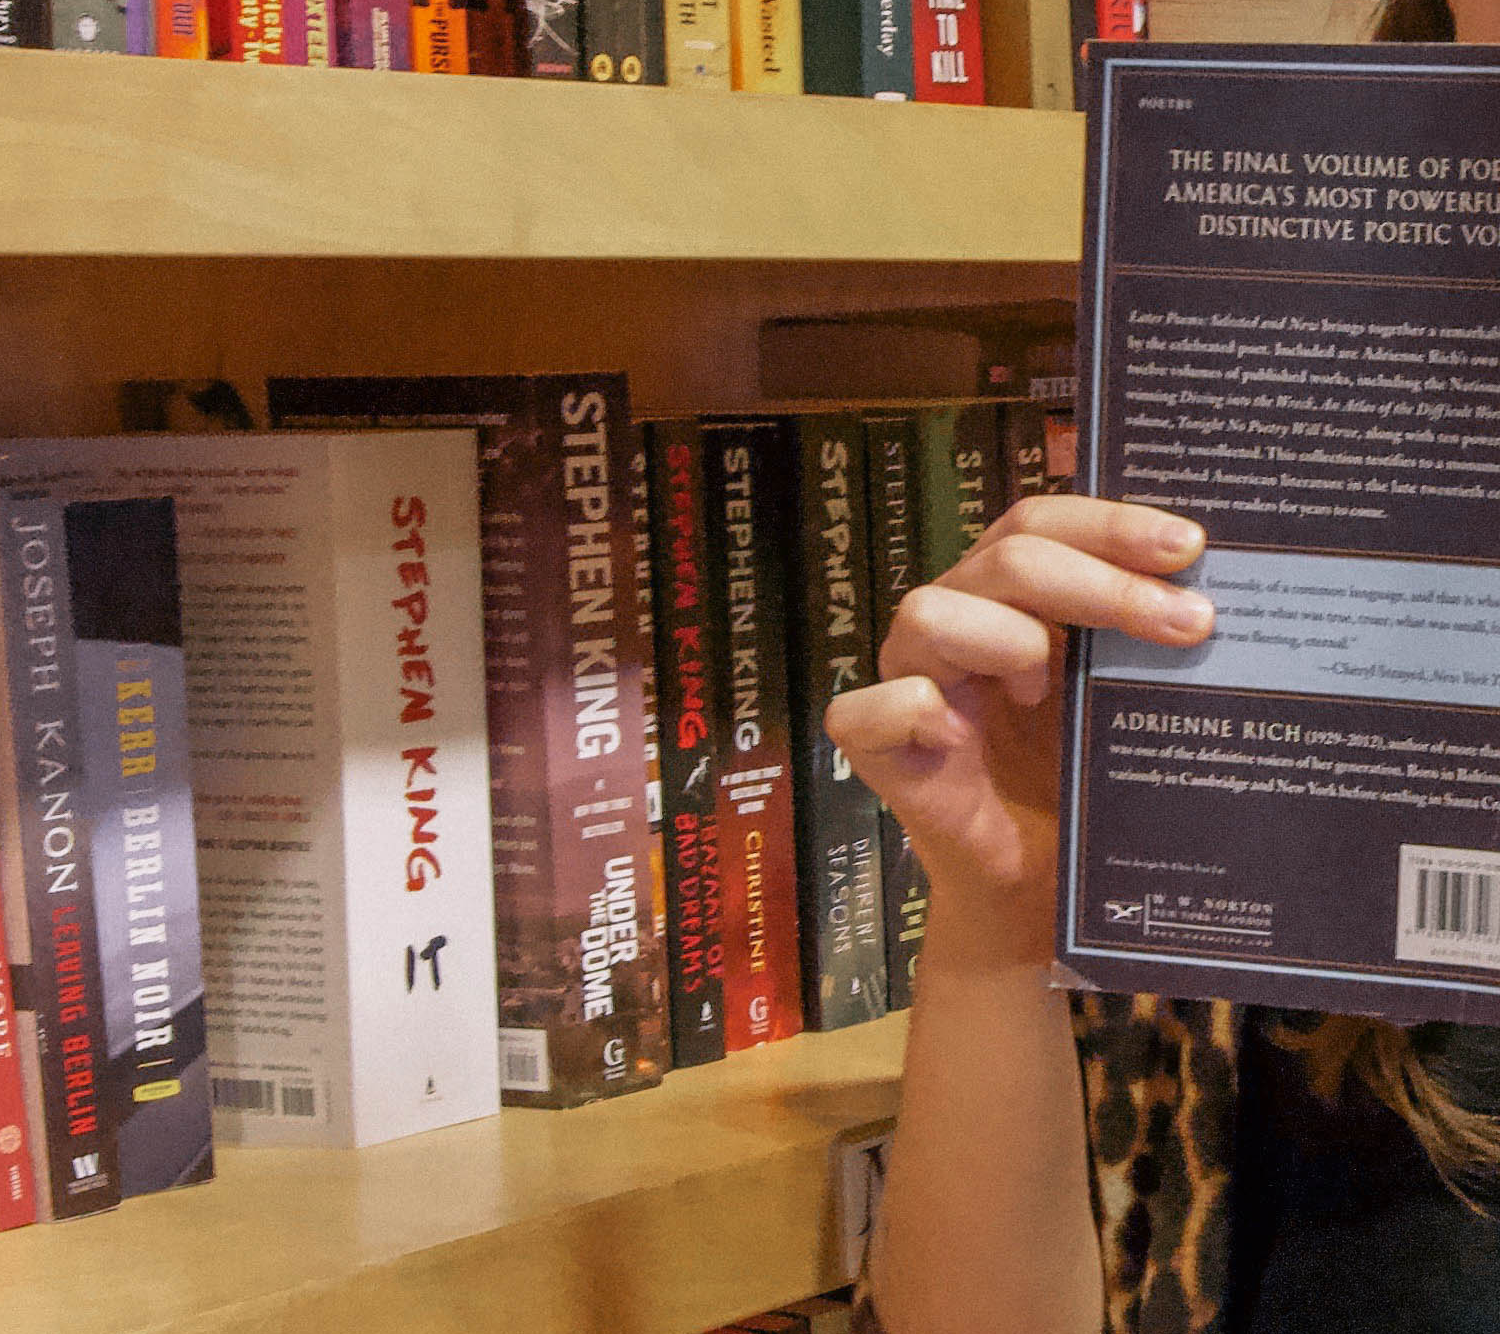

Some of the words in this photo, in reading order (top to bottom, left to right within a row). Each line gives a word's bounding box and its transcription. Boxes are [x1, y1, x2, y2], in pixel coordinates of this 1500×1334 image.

[929, 51, 969, 83] KILL
[936, 15, 960, 46] TO
[1164, 183, 1295, 207] AMERICA'S
[1304, 188, 1373, 210] MOST
[1169, 150, 1213, 172] THE
[1222, 152, 1293, 173] FINAL
[1303, 154, 1409, 178] VOLUME
[1419, 157, 1451, 179] OF
[1199, 215, 1354, 241] DISTINCTIVE
[1364, 221, 1451, 245] POETIC
[559, 389, 618, 635] STEPHEN
[391, 494, 437, 727] STEPHEN
[116, 676, 156, 779] KERR
[572, 636, 621, 761] KING
[1111, 712, 1233, 738] ADRIENNE
[1243, 721, 1301, 743] RICH
[398, 745, 444, 895] KING
[120, 805, 166, 950] BERLIN
[588, 885, 610, 928] THE
[601, 855, 640, 968] UNDER
[130, 959, 175, 1053] NOIR
[404, 934, 447, 994] IT
[581, 921, 614, 1024] DOME
